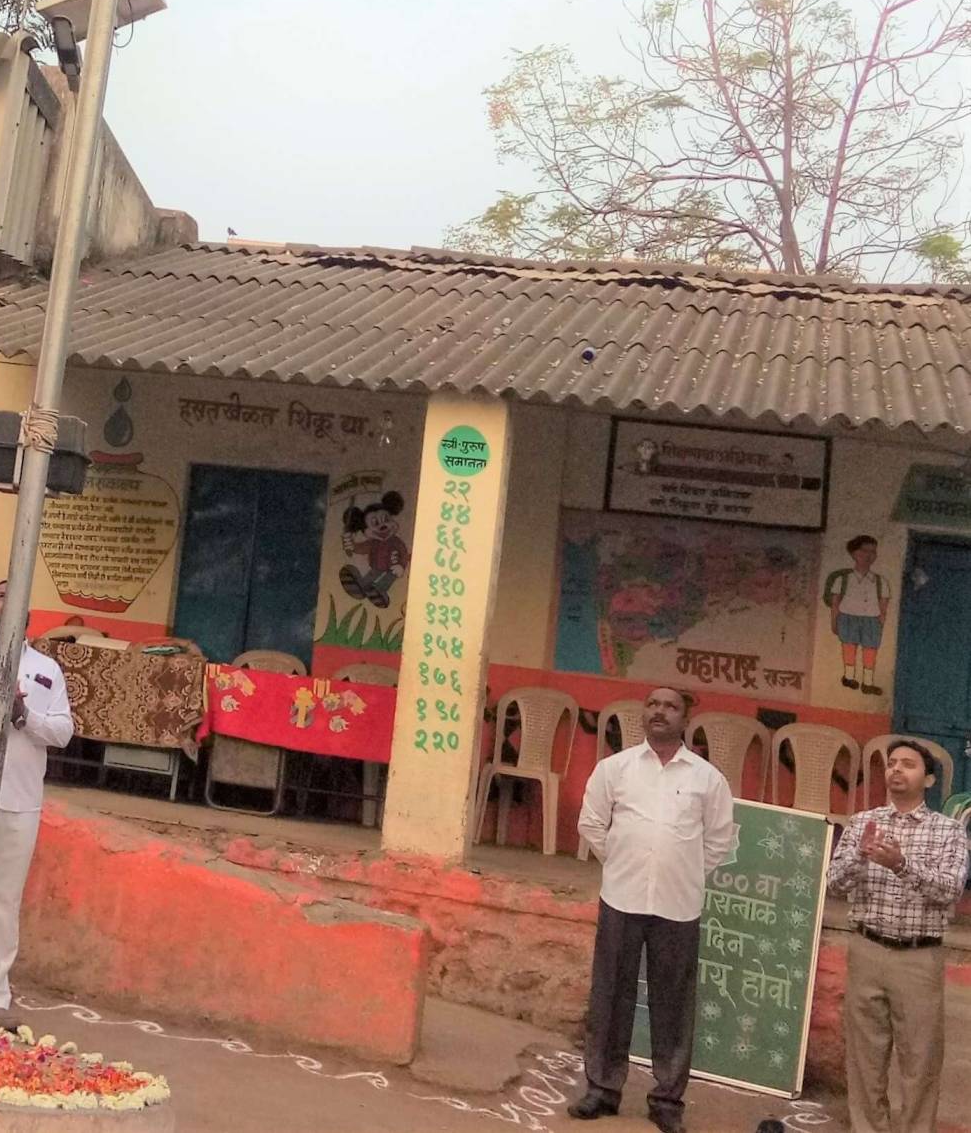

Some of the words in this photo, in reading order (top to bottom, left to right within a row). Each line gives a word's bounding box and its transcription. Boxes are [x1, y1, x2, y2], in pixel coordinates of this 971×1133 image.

[444, 480, 471, 502] २२
[440, 501, 471, 525] ४४
[436, 524, 467, 553] ६६
[434, 548, 461, 572] ८८
[428, 574, 466, 598] ११०
[426, 602, 462, 631] १३२
[423, 632, 464, 659] १५४
[419, 662, 462, 696] १७६
[676, 647, 760, 690] महाराष्ट्र
[762, 668, 805, 691] राज्य
[416, 698, 460, 722] १९८
[414, 729, 459, 754] २२०
[755, 873, 781, 900] वा
[699, 917, 756, 958] दिन
